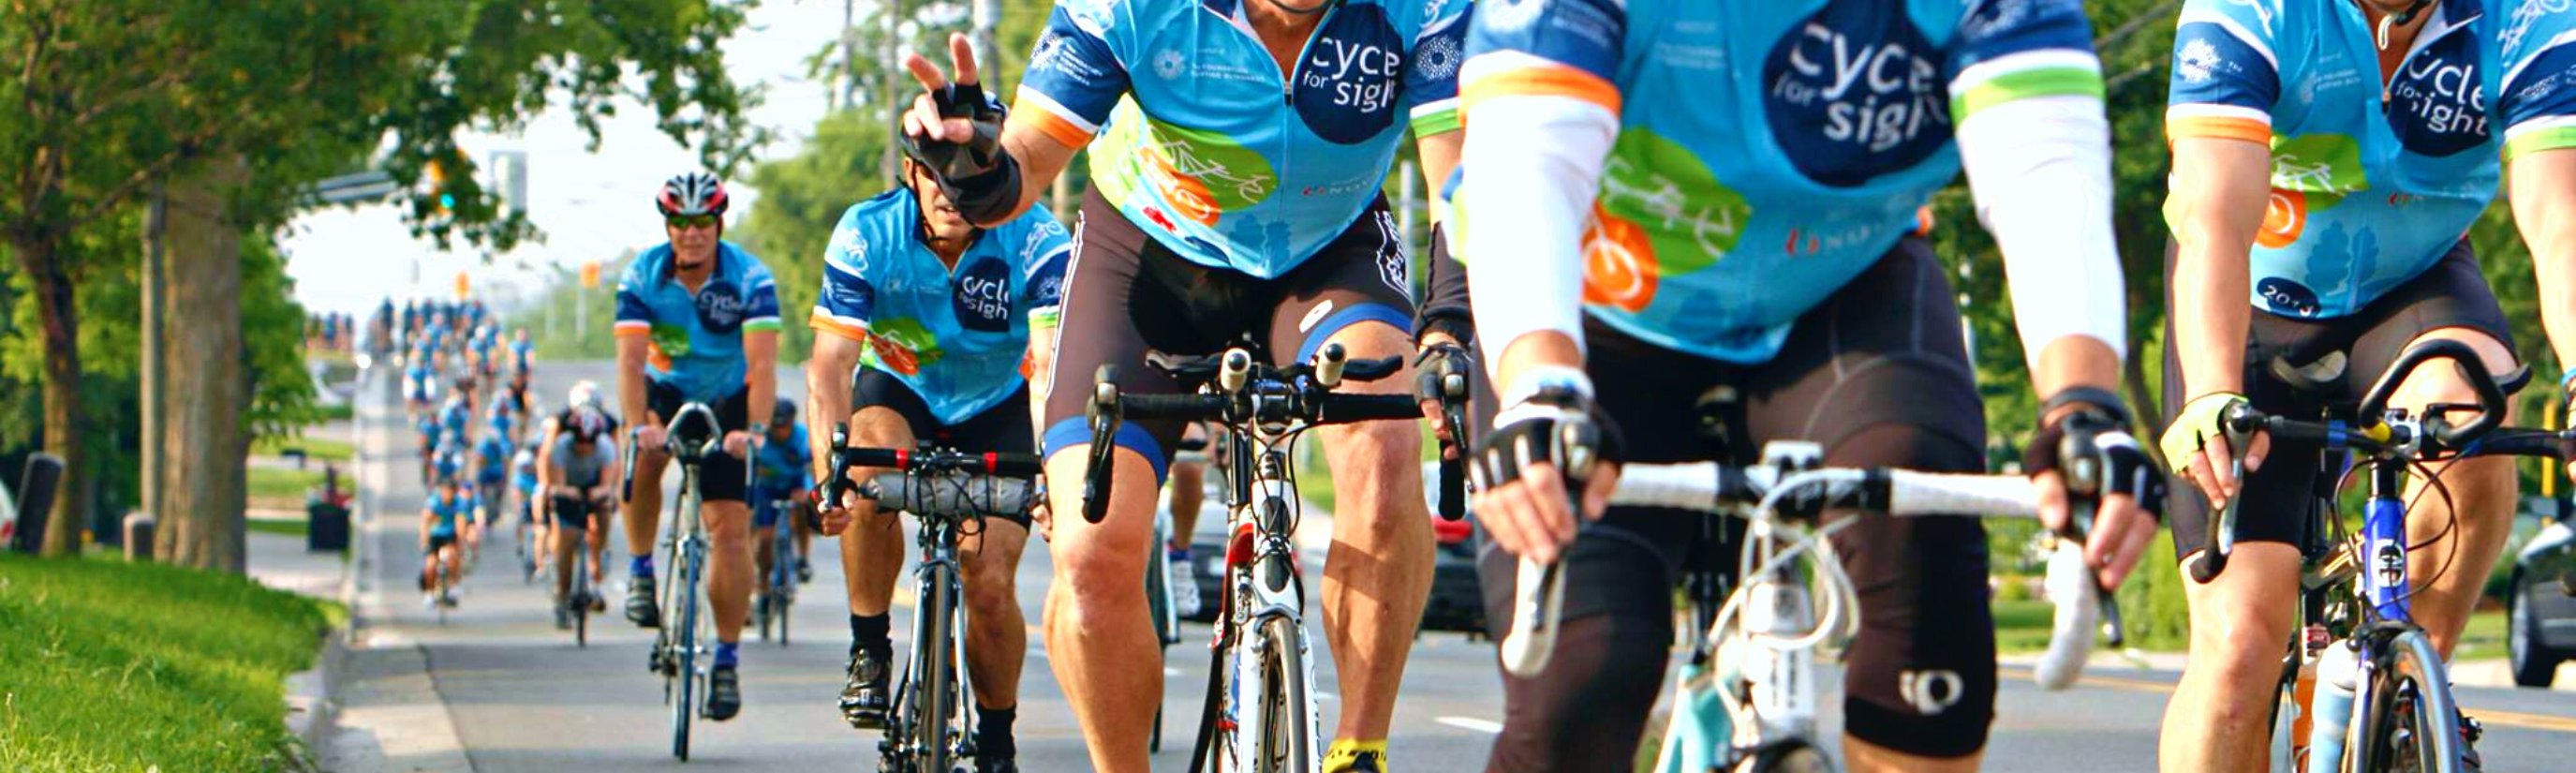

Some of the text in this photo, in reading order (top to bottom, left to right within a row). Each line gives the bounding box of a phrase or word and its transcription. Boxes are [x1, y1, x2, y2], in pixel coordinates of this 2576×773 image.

[1312, 37, 1400, 80] cyce
[1790, 22, 1935, 99] cyce
[1303, 70, 1397, 113] for sigh
[1824, 95, 1948, 152] sigh
[967, 296, 1008, 320] sigh
